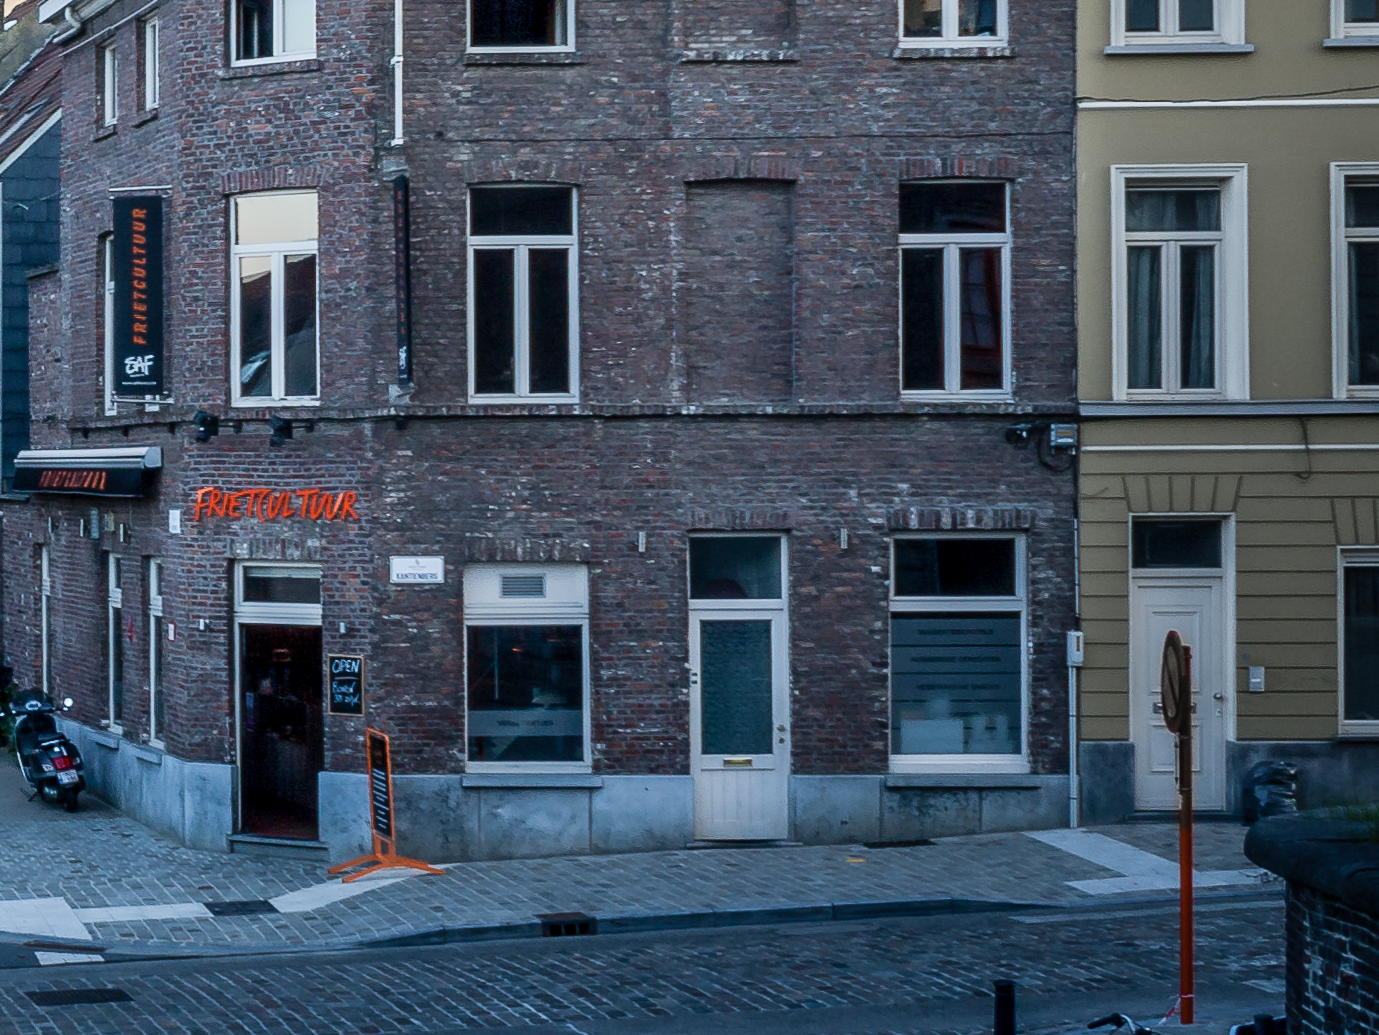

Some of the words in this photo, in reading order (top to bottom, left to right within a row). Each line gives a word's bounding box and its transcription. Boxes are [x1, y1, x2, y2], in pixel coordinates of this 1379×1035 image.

[132, 207, 148, 345] FRIETCULTUUR
[194, 486, 359, 522] FRIETCULTUUR
[332, 659, 360, 673] OPEN
